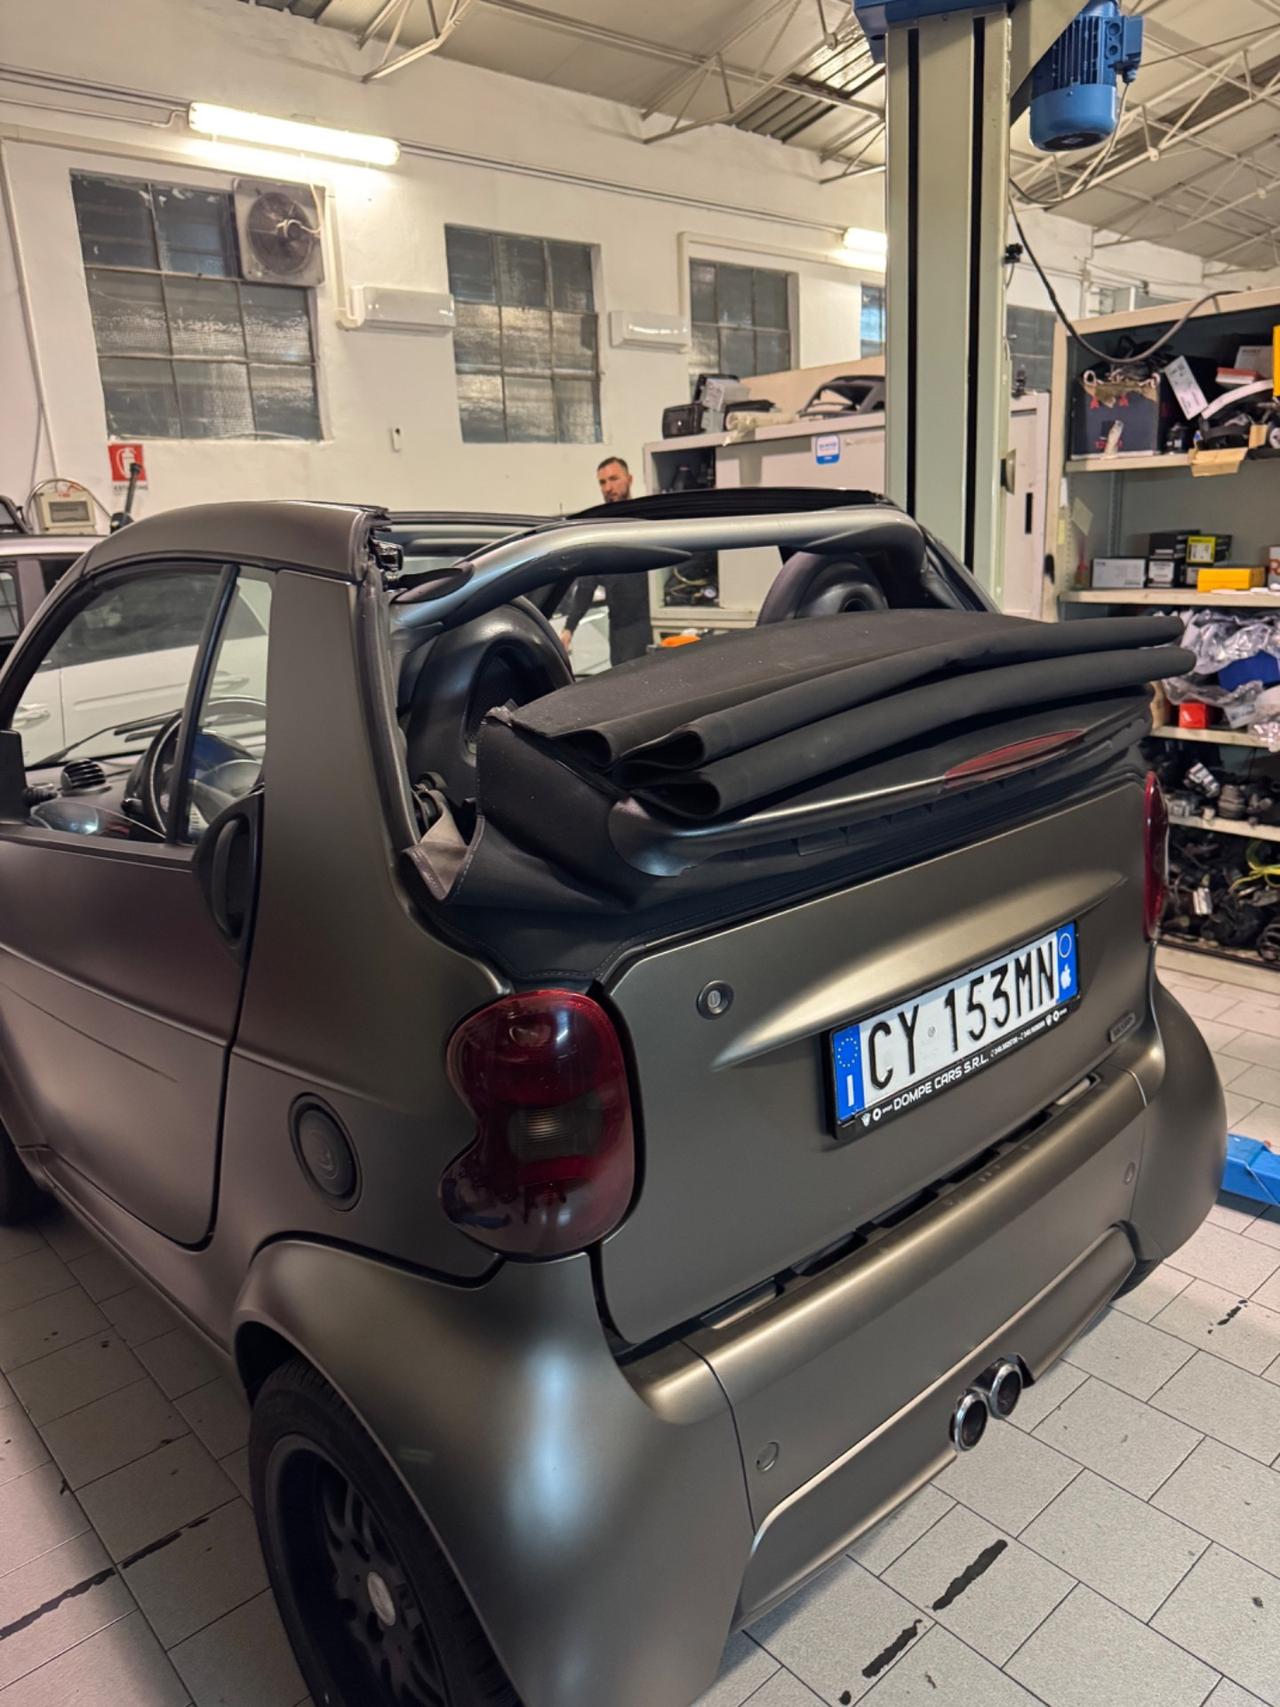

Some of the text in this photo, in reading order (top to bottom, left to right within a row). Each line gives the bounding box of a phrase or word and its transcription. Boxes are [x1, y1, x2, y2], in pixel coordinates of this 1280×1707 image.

[868, 940, 1055, 1090] CY 153MN
[893, 1081, 933, 1111] DOMPE
[934, 1066, 963, 1090] CARS
[964, 1053, 990, 1074] S.R.L.
